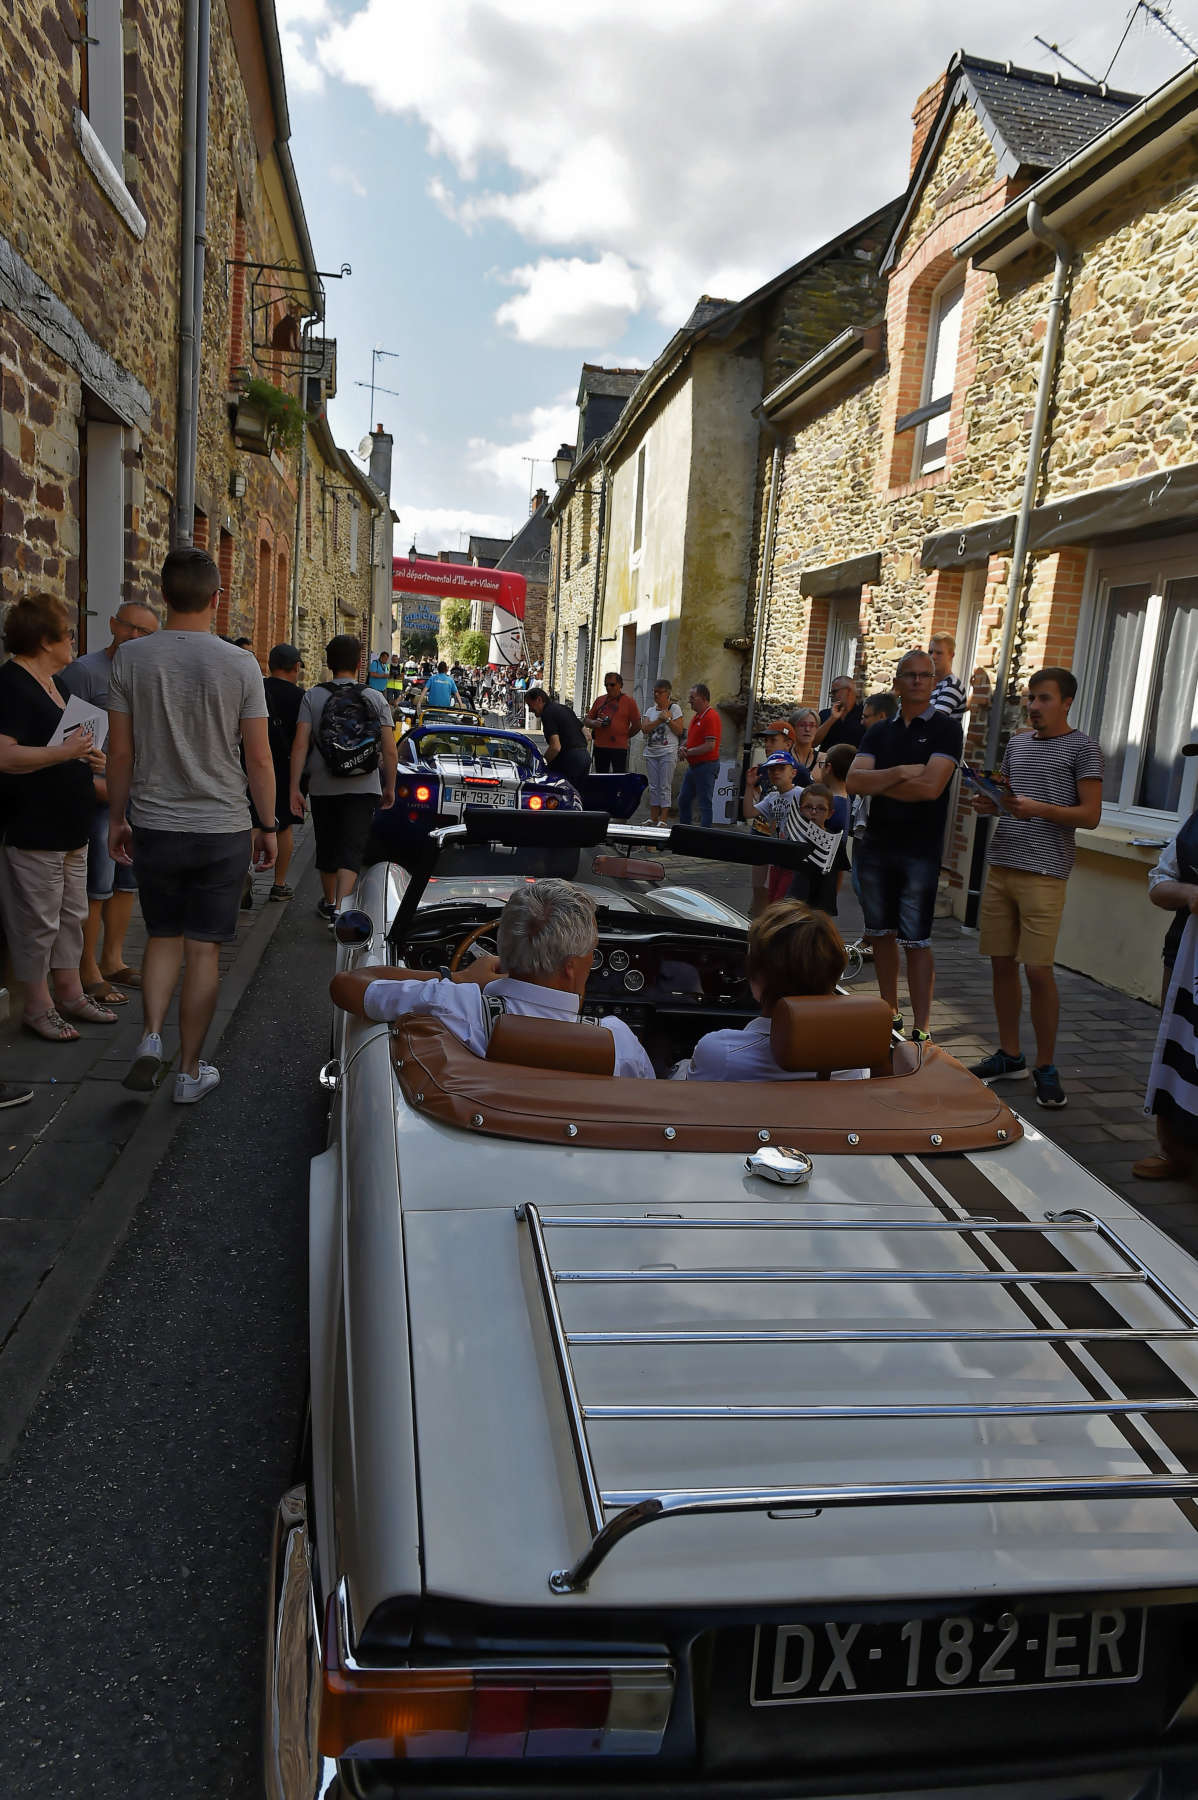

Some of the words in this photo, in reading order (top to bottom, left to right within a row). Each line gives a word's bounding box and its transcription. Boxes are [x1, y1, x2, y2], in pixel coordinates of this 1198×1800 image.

[957, 534, 966, 556] 8
[406, 569, 452, 584] départemental
[453, 790, 506, 805] EM-793-ZG
[771, 1608, 1126, 1695] DX-182-ER
